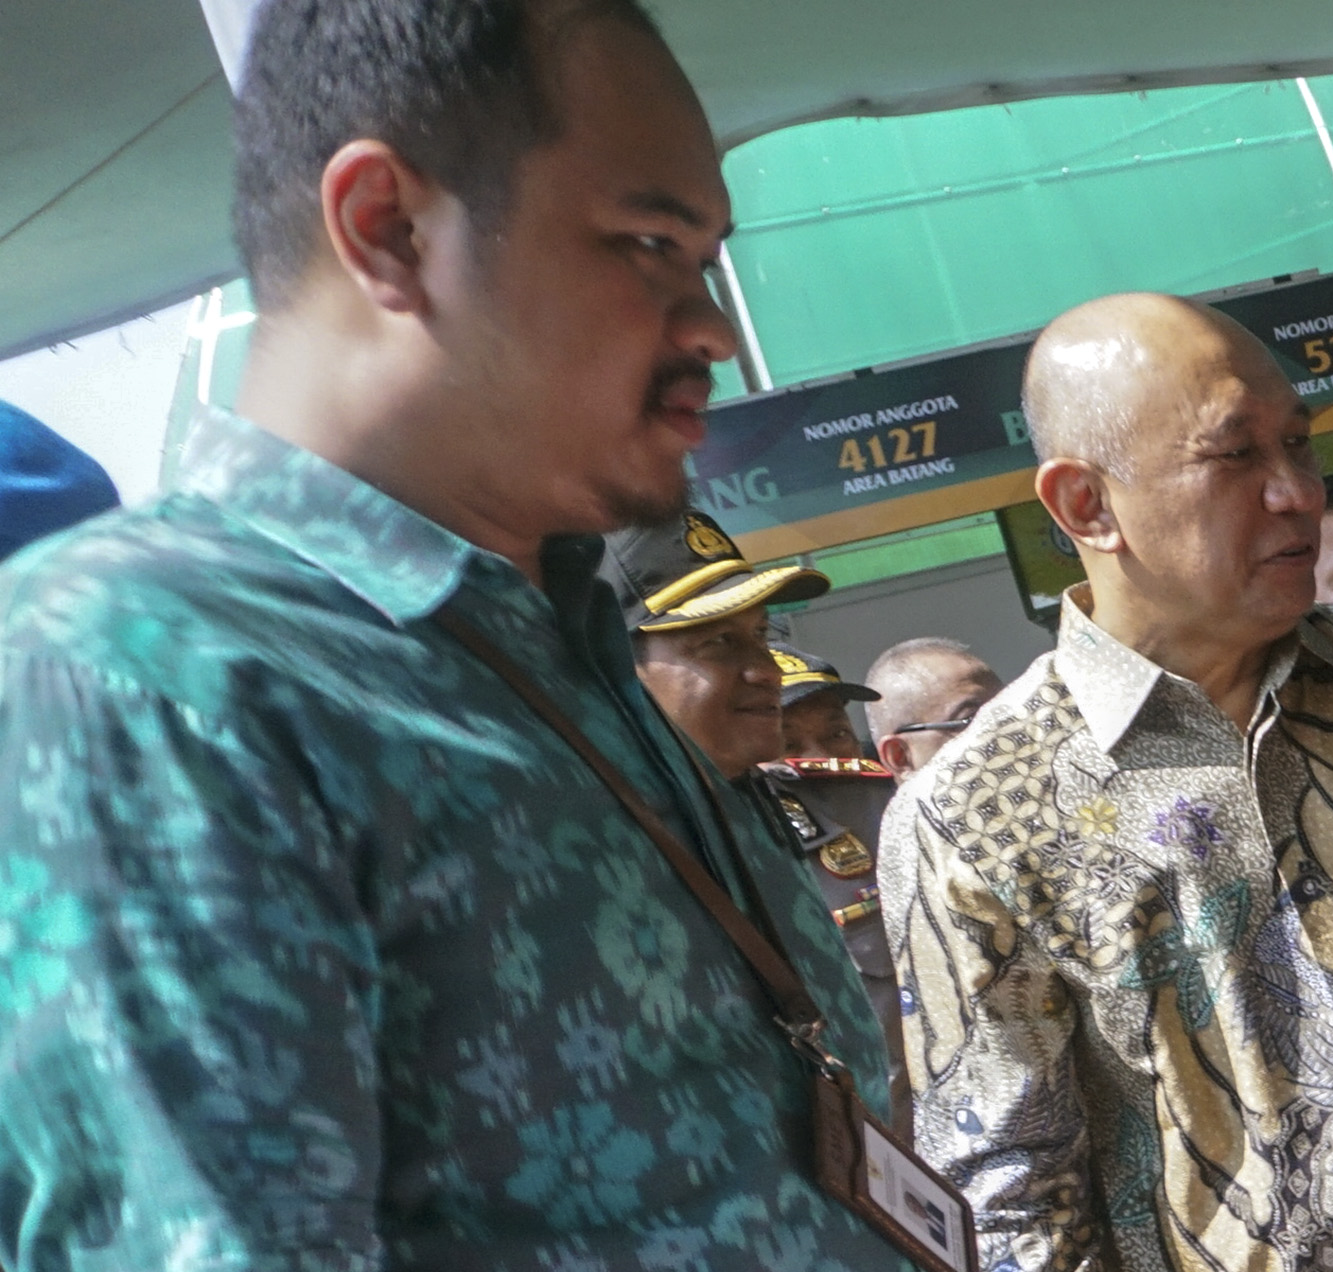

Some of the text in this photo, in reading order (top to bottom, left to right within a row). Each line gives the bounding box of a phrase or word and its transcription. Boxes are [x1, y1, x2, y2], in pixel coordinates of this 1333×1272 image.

[803, 395, 960, 442] NOMOR ANGGOTA
[1001, 411, 1030, 447] B
[837, 421, 938, 474] 4127
[842, 457, 956, 496] AREA BATANG
